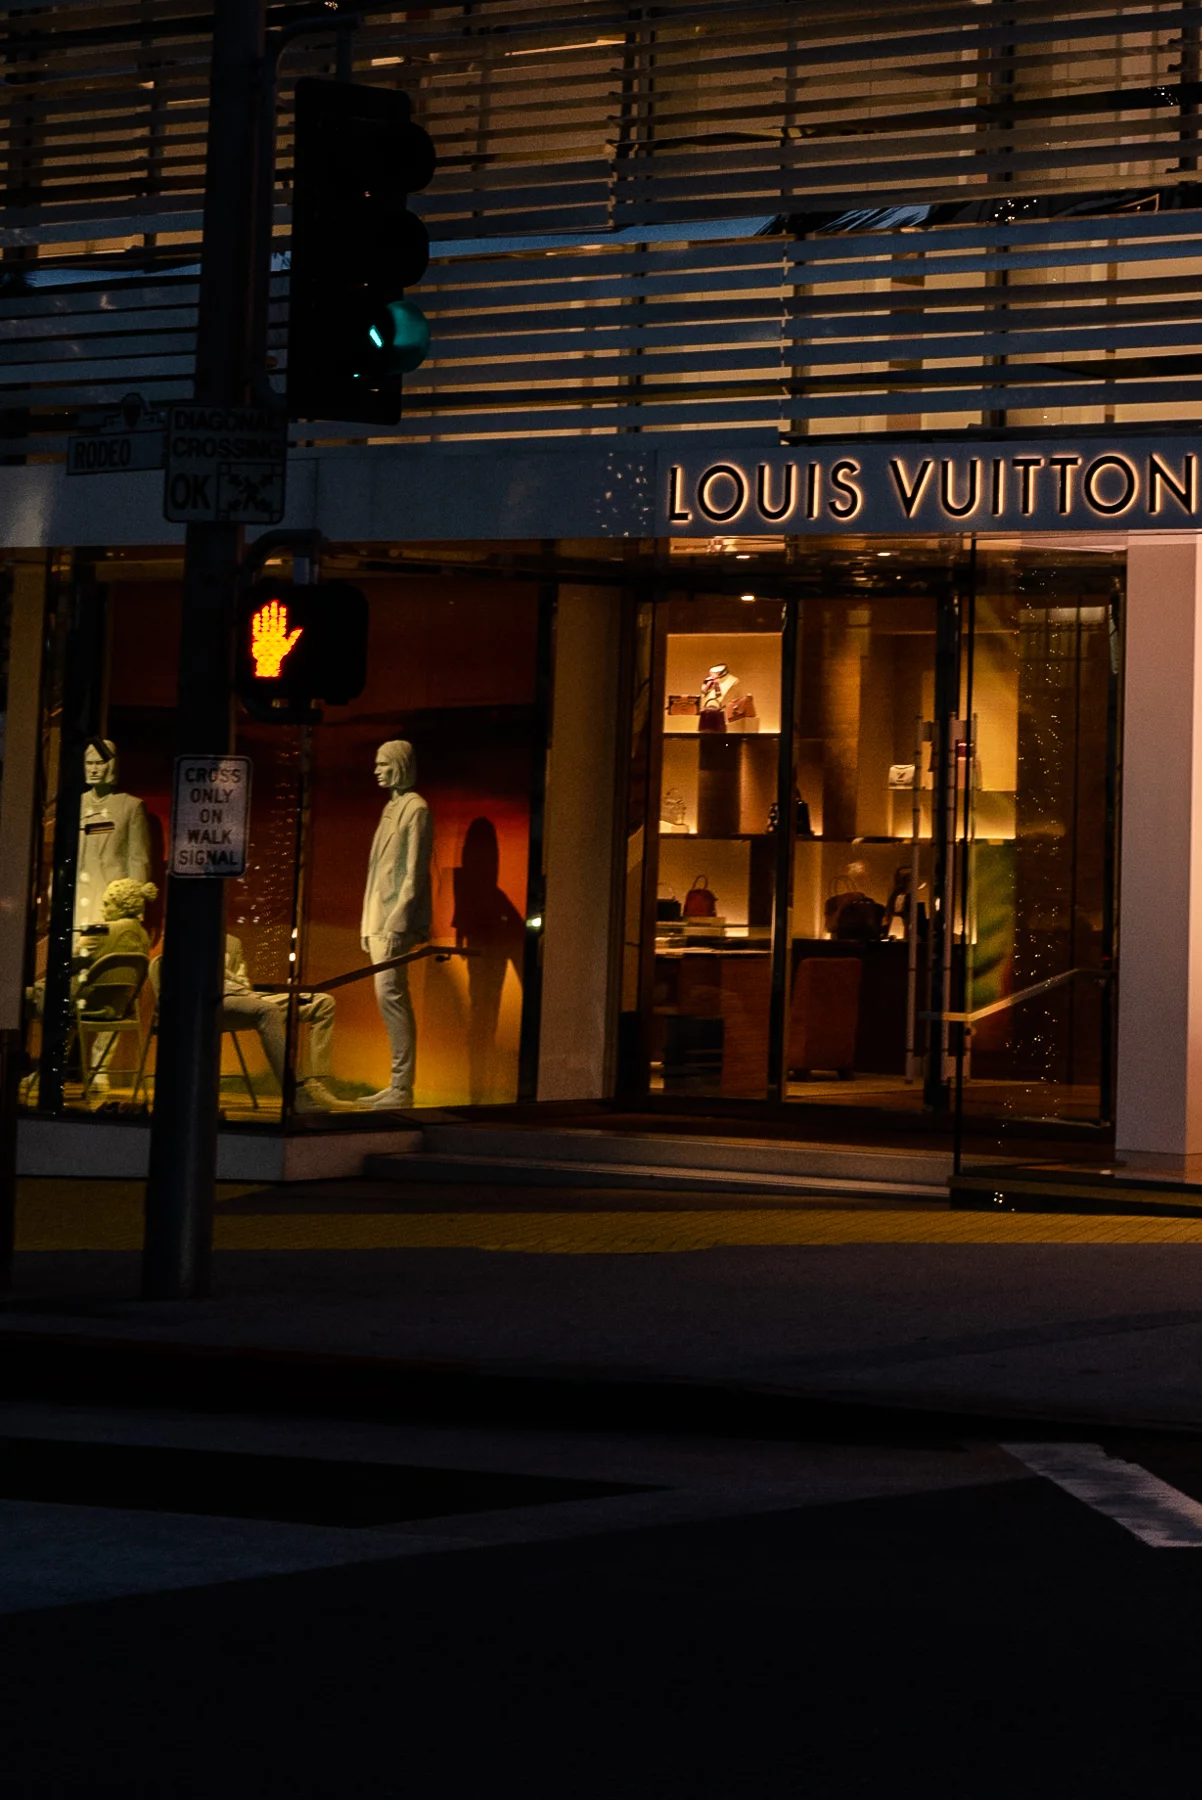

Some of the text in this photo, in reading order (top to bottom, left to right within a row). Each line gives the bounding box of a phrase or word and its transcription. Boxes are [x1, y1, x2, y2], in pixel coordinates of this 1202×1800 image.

[174, 410, 281, 432] DIAGONAL
[74, 439, 131, 469] RODEO
[172, 437, 281, 460] CROSSING
[171, 473, 211, 510] OK
[668, 451, 1199, 523] LOUIS VUITTON
[185, 767, 241, 783] CROSS
[190, 788, 234, 804] ONLY
[200, 809, 223, 824] ON
[188, 829, 233, 845] WALK
[180, 849, 238, 866] SIGNAL
